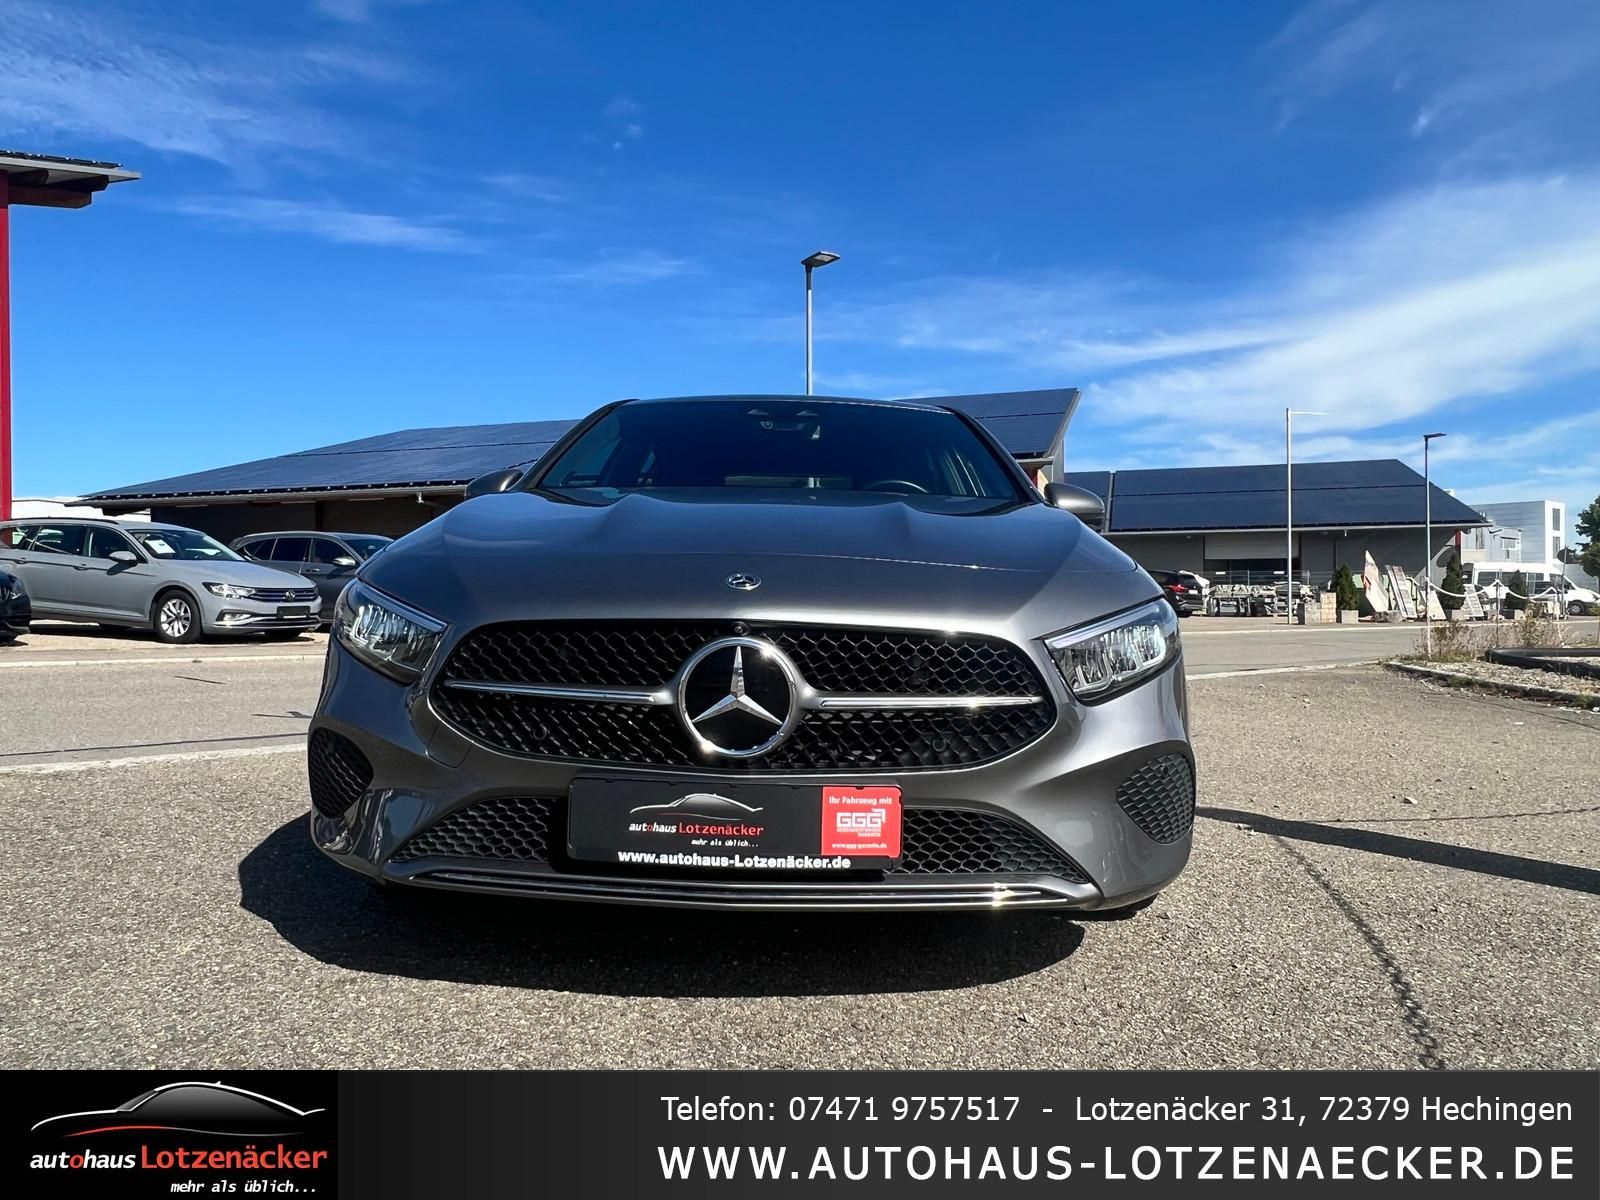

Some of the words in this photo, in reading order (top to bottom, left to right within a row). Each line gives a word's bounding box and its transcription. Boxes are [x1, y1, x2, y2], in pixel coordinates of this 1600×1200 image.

[829, 796, 840, 804] Ihr
[842, 796, 877, 805] Fahrzeug
[879, 796, 892, 804] mit
[836, 812, 882, 828] GGG
[629, 822, 677, 833] autohaus
[679, 822, 764, 836] Lotzenäcker
[710, 838, 722, 846] als
[618, 851, 851, 869] www.autohaus-Lotzenäcker.de
